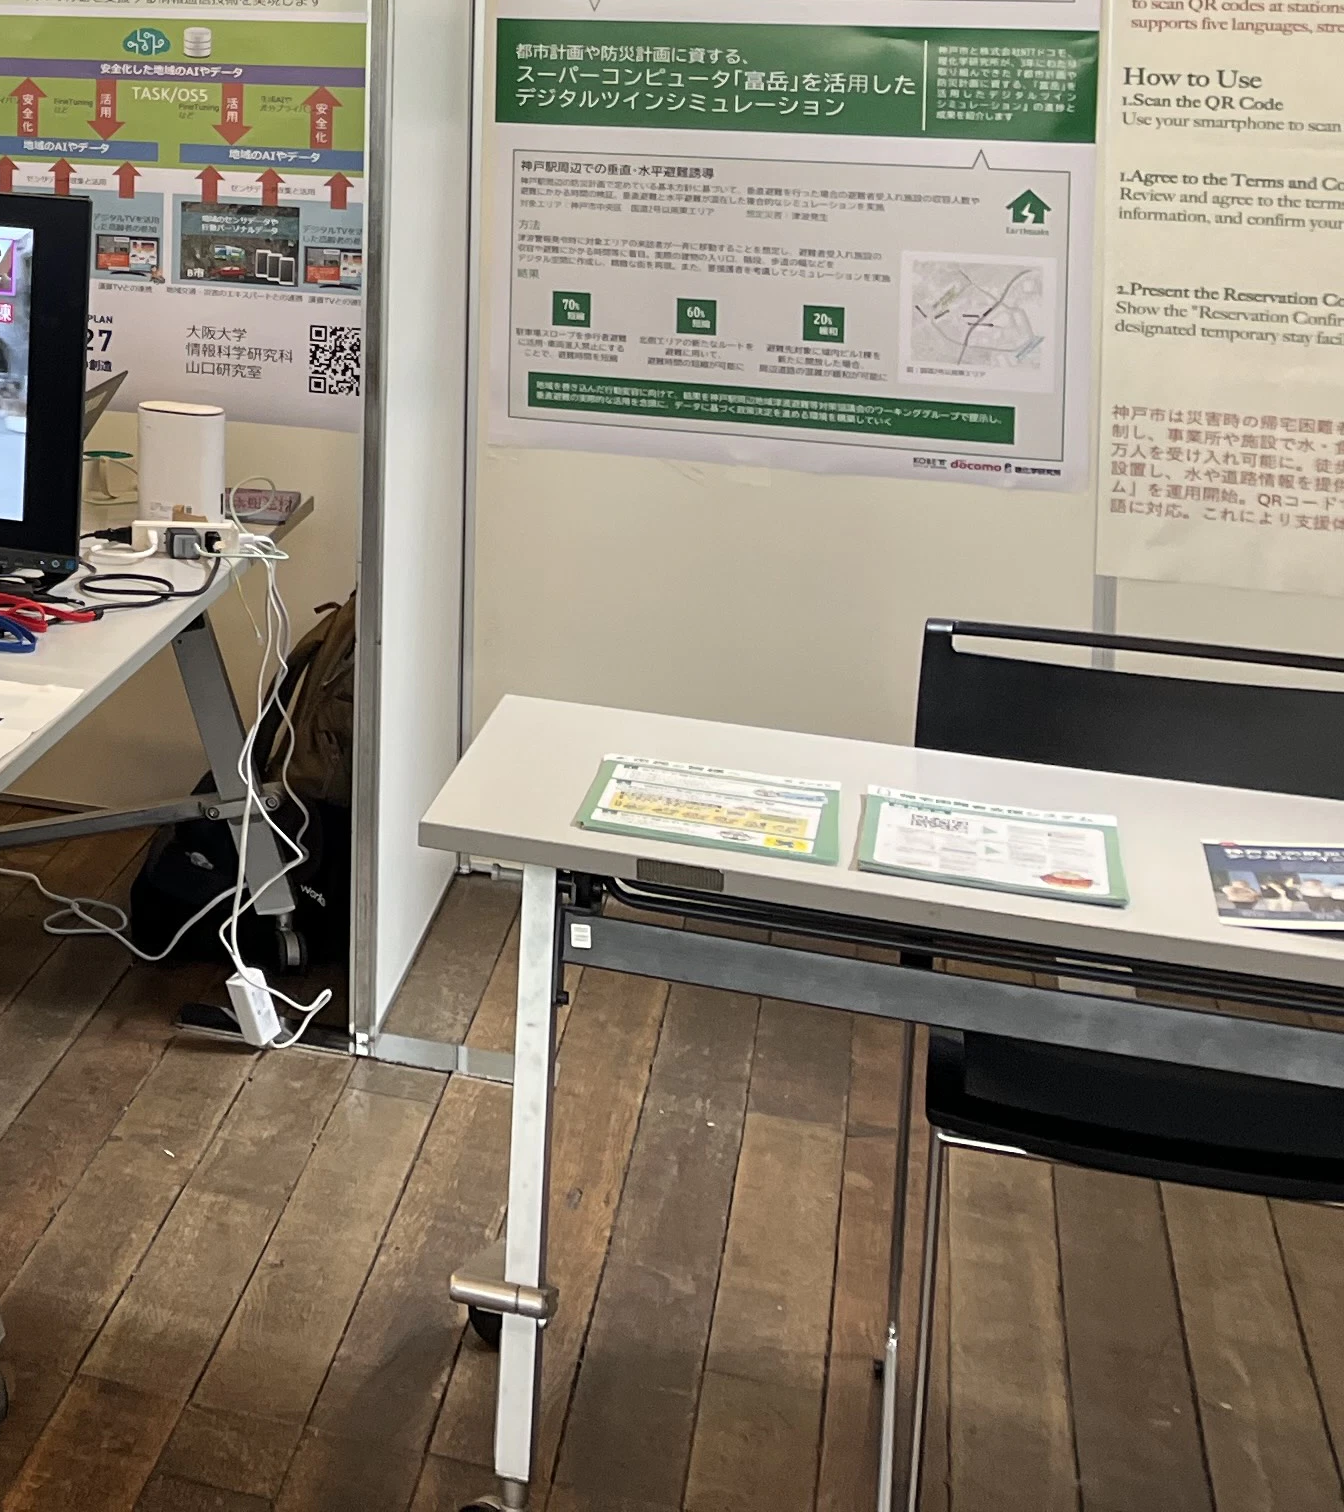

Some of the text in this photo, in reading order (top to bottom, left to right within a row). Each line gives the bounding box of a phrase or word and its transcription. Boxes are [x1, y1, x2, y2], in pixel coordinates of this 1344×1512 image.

[1132, 0, 1147, 9] to
[1151, 0, 1184, 10] scan
[1221, 0, 1264, 12] codes
[1269, 3, 1283, 13] at
[1131, 17, 1312, 35] supports five languages,
[516, 43, 749, 66] 都市計画や防災計画に資する、
[515, 66, 916, 96] スーパーコンピュータ「富岳」を活用した
[1123, 67, 1262, 89] How to Use
[100, 93, 112, 118] 活用
[226, 98, 238, 123] 活用
[514, 87, 846, 117] デジタルツインシミュレーション
[1176, 96, 1283, 110] the QR Code
[22, 94, 34, 133] 安全化
[315, 103, 328, 143] 安全化
[1123, 112, 1341, 133] Use your smartphone to scan
[1183, 172, 1317, 190] to the Terms and
[1120, 187, 1301, 208] Review and agree to the
[518, 220, 540, 230] 方法
[1119, 207, 1211, 224] information,
[1215, 213, 1243, 225] and
[1247, 212, 1305, 228] confirm
[1194, 286, 1317, 305] the Reservation
[1116, 301, 1160, 315] Show
[1164, 304, 1188, 318] the
[186, 326, 248, 341] 大阪大学
[1115, 319, 1312, 347] designated temporary stay
[186, 342, 293, 363] 情報科学研究科
[186, 361, 262, 379] 山口研究室
